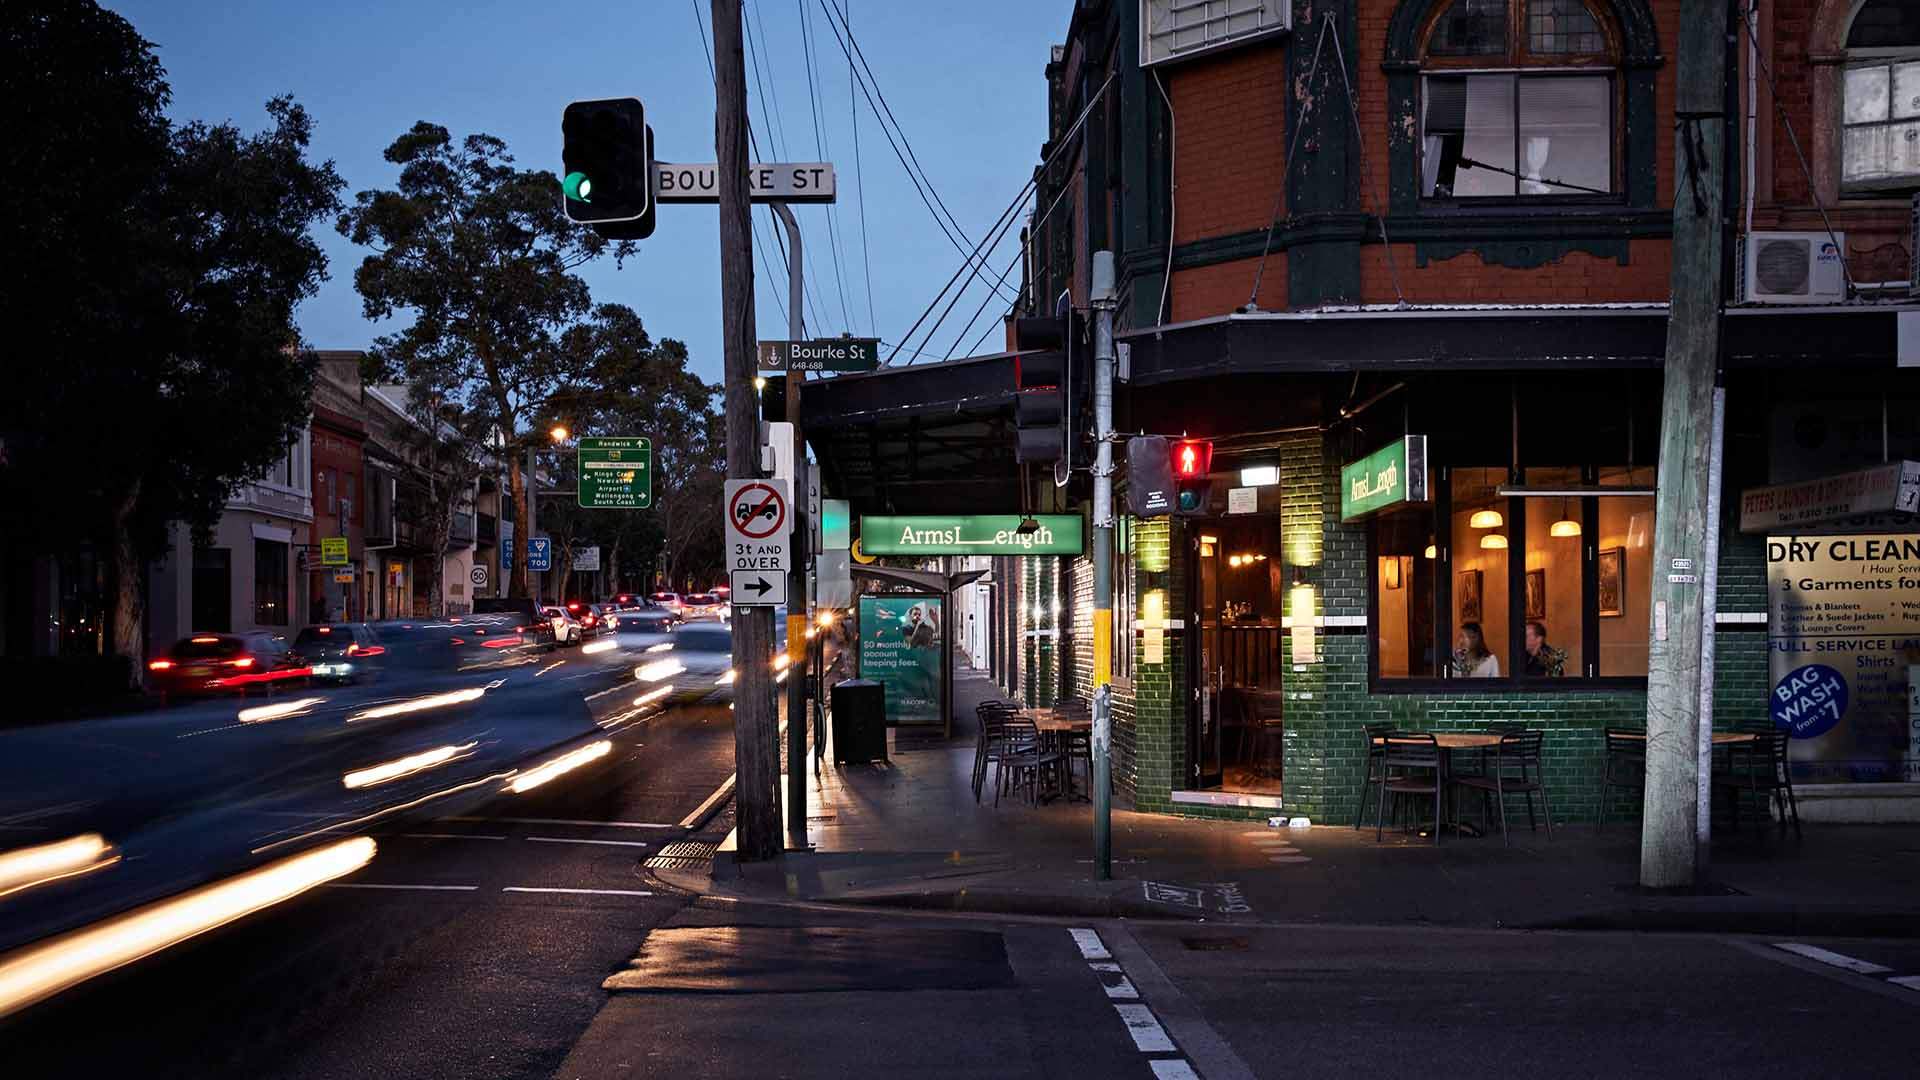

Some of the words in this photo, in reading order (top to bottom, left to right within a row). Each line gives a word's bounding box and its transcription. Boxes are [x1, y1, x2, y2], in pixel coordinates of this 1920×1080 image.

[660, 169, 774, 189] BOUKE
[793, 169, 825, 189] ST
[791, 344, 845, 359] Bourke
[849, 344, 865, 359] St
[791, 361, 823, 370] 648-688
[735, 544, 751, 555] 3t
[758, 545, 782, 555] AND
[1769, 541, 1819, 562] DRY
[1829, 540, 1920, 561] CLEAN
[737, 557, 779, 568] OVER
[1870, 564, 1894, 574] Hour
[473, 572, 484, 580] 50
[1782, 579, 1791, 591] 3
[1799, 578, 1892, 591] Garments
[1824, 602, 1861, 611] Blankets
[1826, 613, 1851, 621] Suede
[1854, 612, 1884, 622] Jackets
[1802, 624, 1832, 634] Lounge
[1835, 623, 1864, 632] Covers
[876, 640, 911, 650] monthly
[1768, 641, 1810, 652] FULL
[1816, 639, 1885, 651] SERVICE
[863, 658, 897, 668] keeping
[1857, 655, 1896, 668] Shirts
[1775, 666, 1820, 703] BAG
[1776, 675, 1843, 724] WASH
[1795, 713, 1819, 732] from
